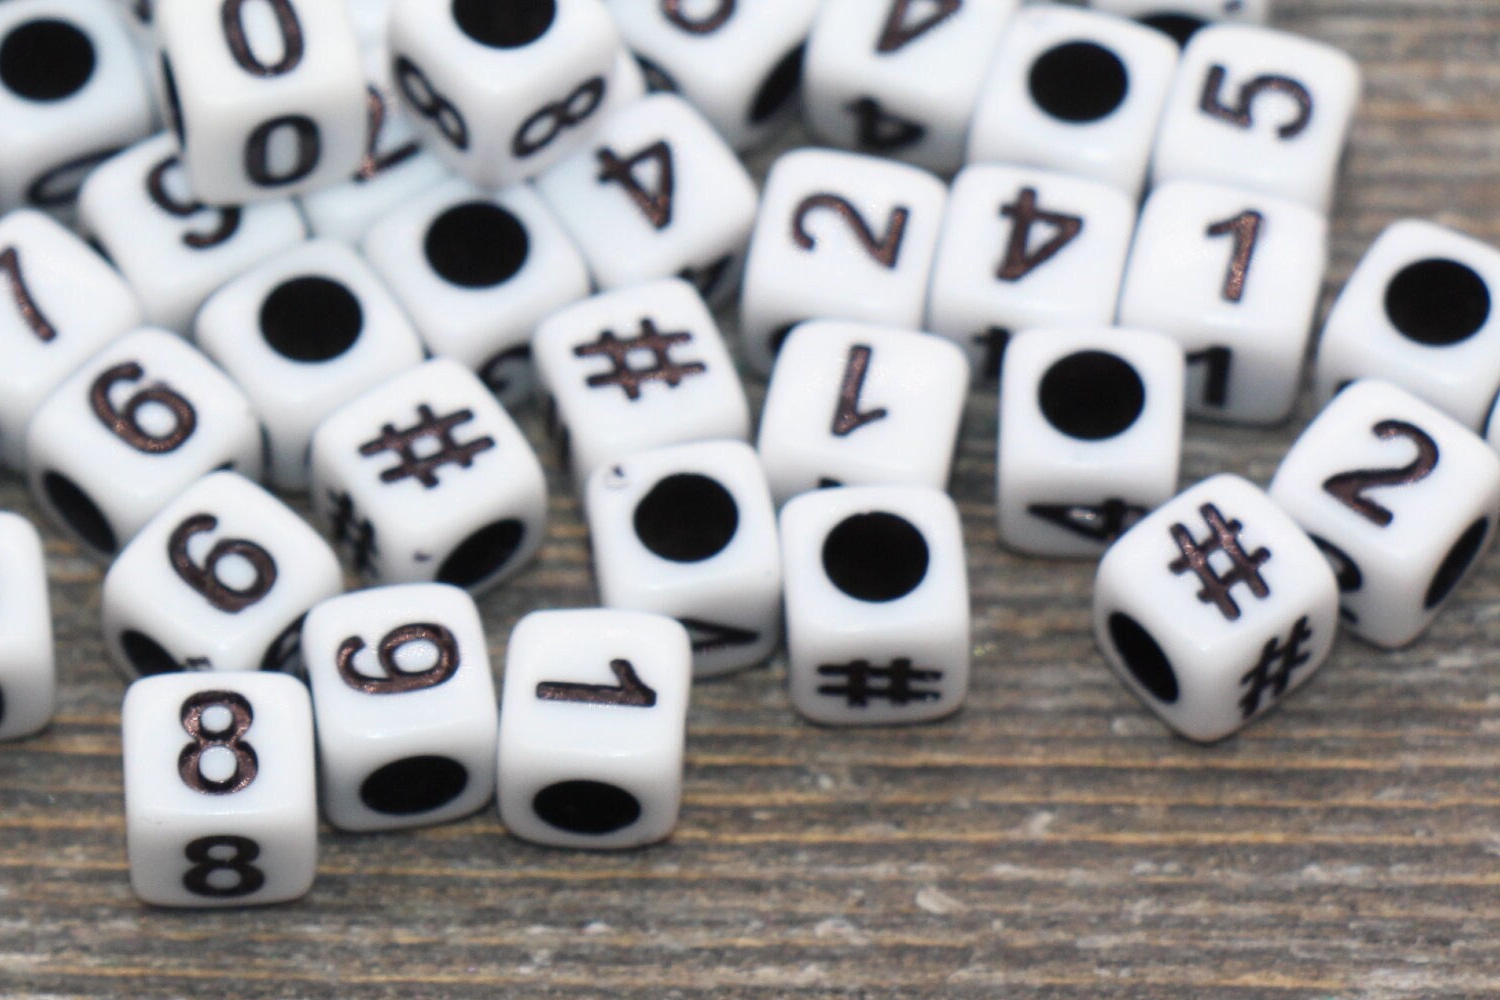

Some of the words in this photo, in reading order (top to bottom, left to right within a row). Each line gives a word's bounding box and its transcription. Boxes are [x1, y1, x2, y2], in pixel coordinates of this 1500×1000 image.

[220, 0, 306, 78] 0
[388, 51, 472, 156] 8
[509, 74, 612, 164] 8
[1198, 63, 1314, 140] 5
[241, 112, 325, 191] 0
[594, 139, 676, 232] 4
[791, 192, 910, 270] 2
[995, 186, 1084, 284] 4
[1206, 209, 1264, 304] 1
[572, 317, 707, 402] #
[830, 343, 888, 438] 1
[357, 403, 496, 490] #
[1321, 418, 1441, 528] 2
[1167, 501, 1273, 622] #
[534, 657, 658, 709] 1
[812, 653, 948, 712] #
[176, 689, 260, 797] 8
[182, 835, 265, 898] 8
